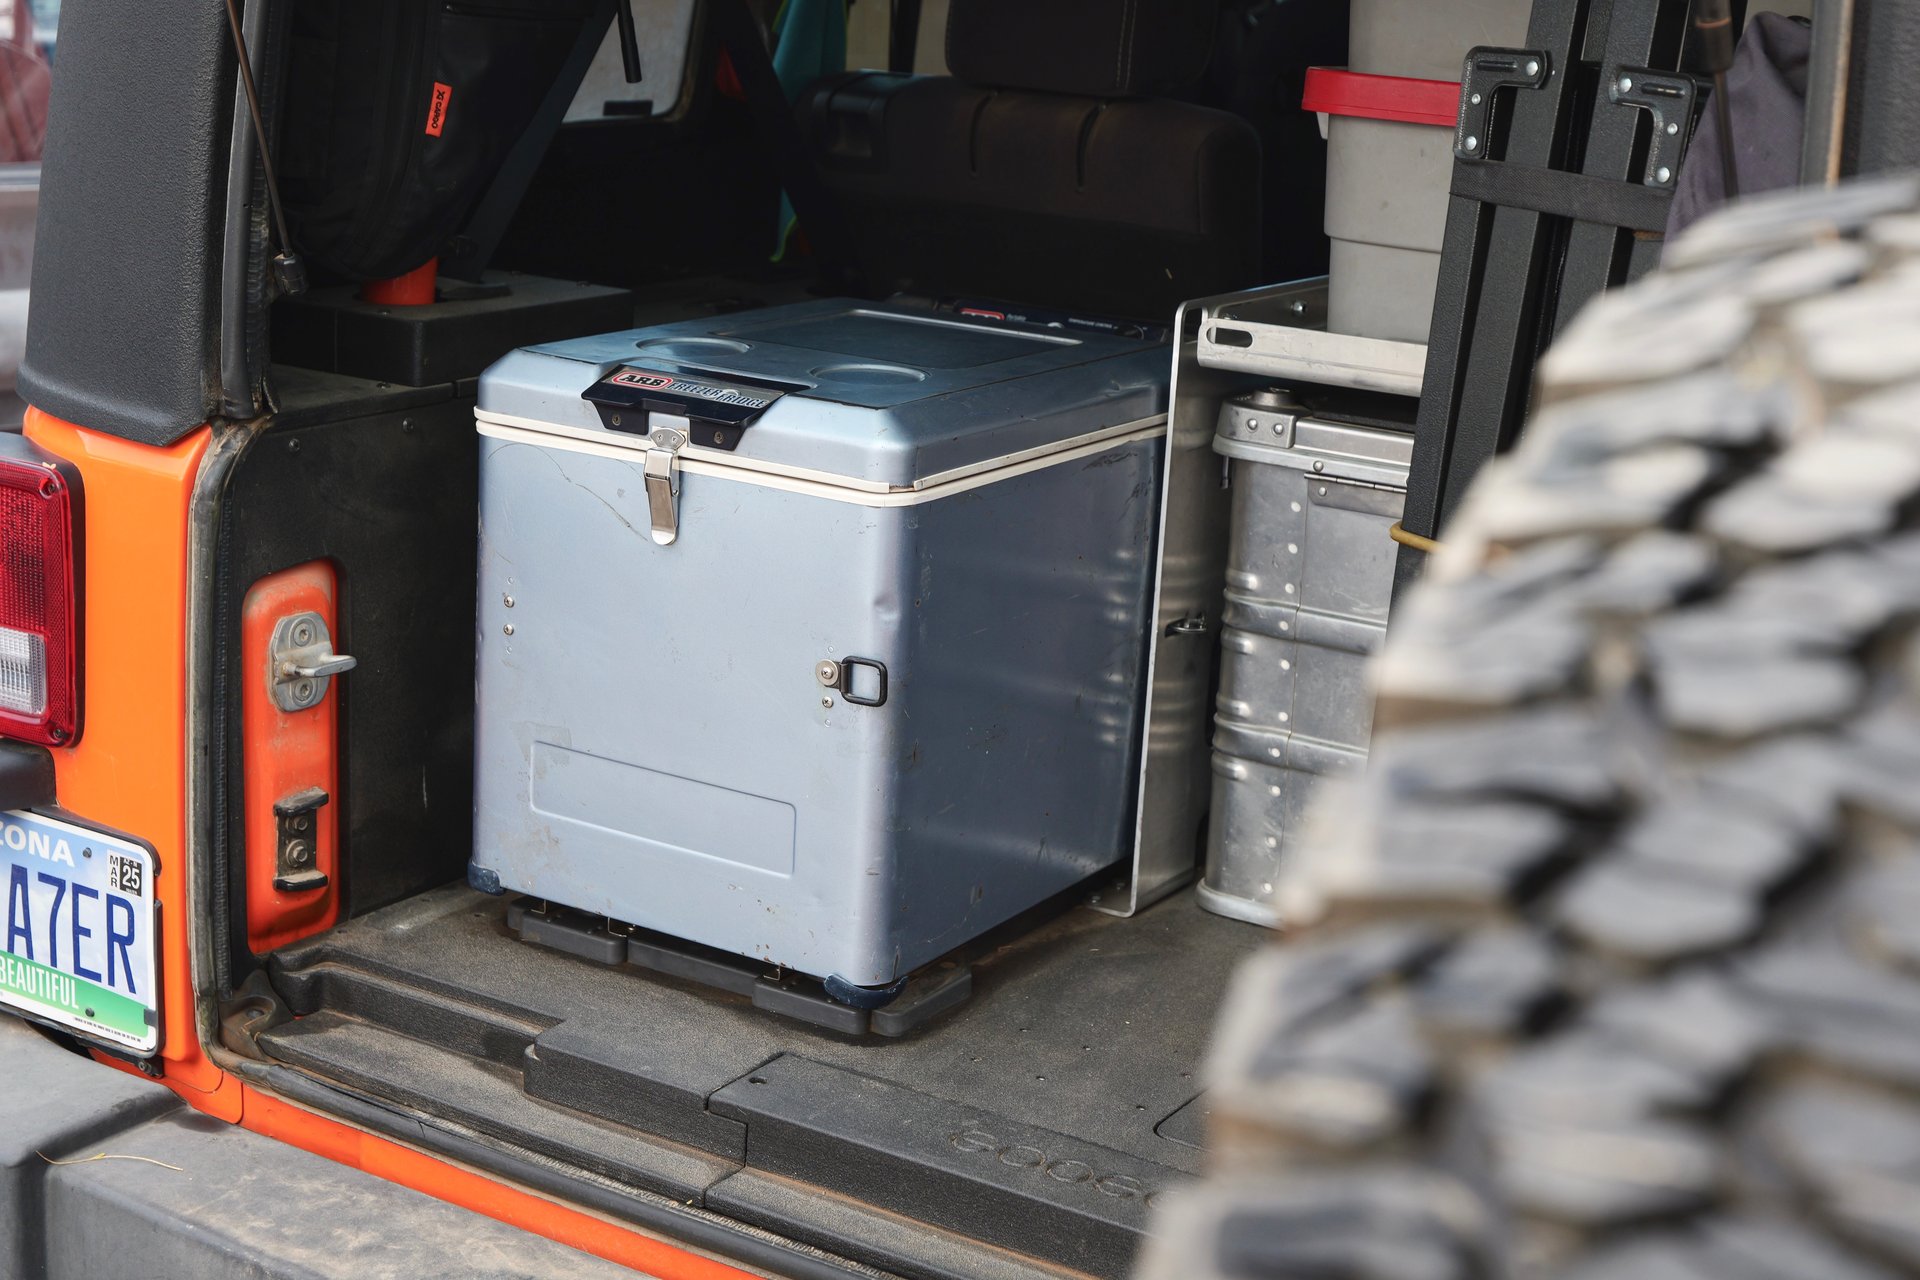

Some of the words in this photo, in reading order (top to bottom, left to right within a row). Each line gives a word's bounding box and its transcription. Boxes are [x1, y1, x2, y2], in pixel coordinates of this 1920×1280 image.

[431, 101, 442, 129] CARGO
[620, 374, 665, 388] ARB
[667, 381, 723, 397] FREEZER
[714, 393, 766, 409] FRIDGE
[0, 821, 75, 868] ONA
[109, 855, 119, 888] MAR
[122, 864, 140, 890] 25
[7, 863, 137, 995] A7ER
